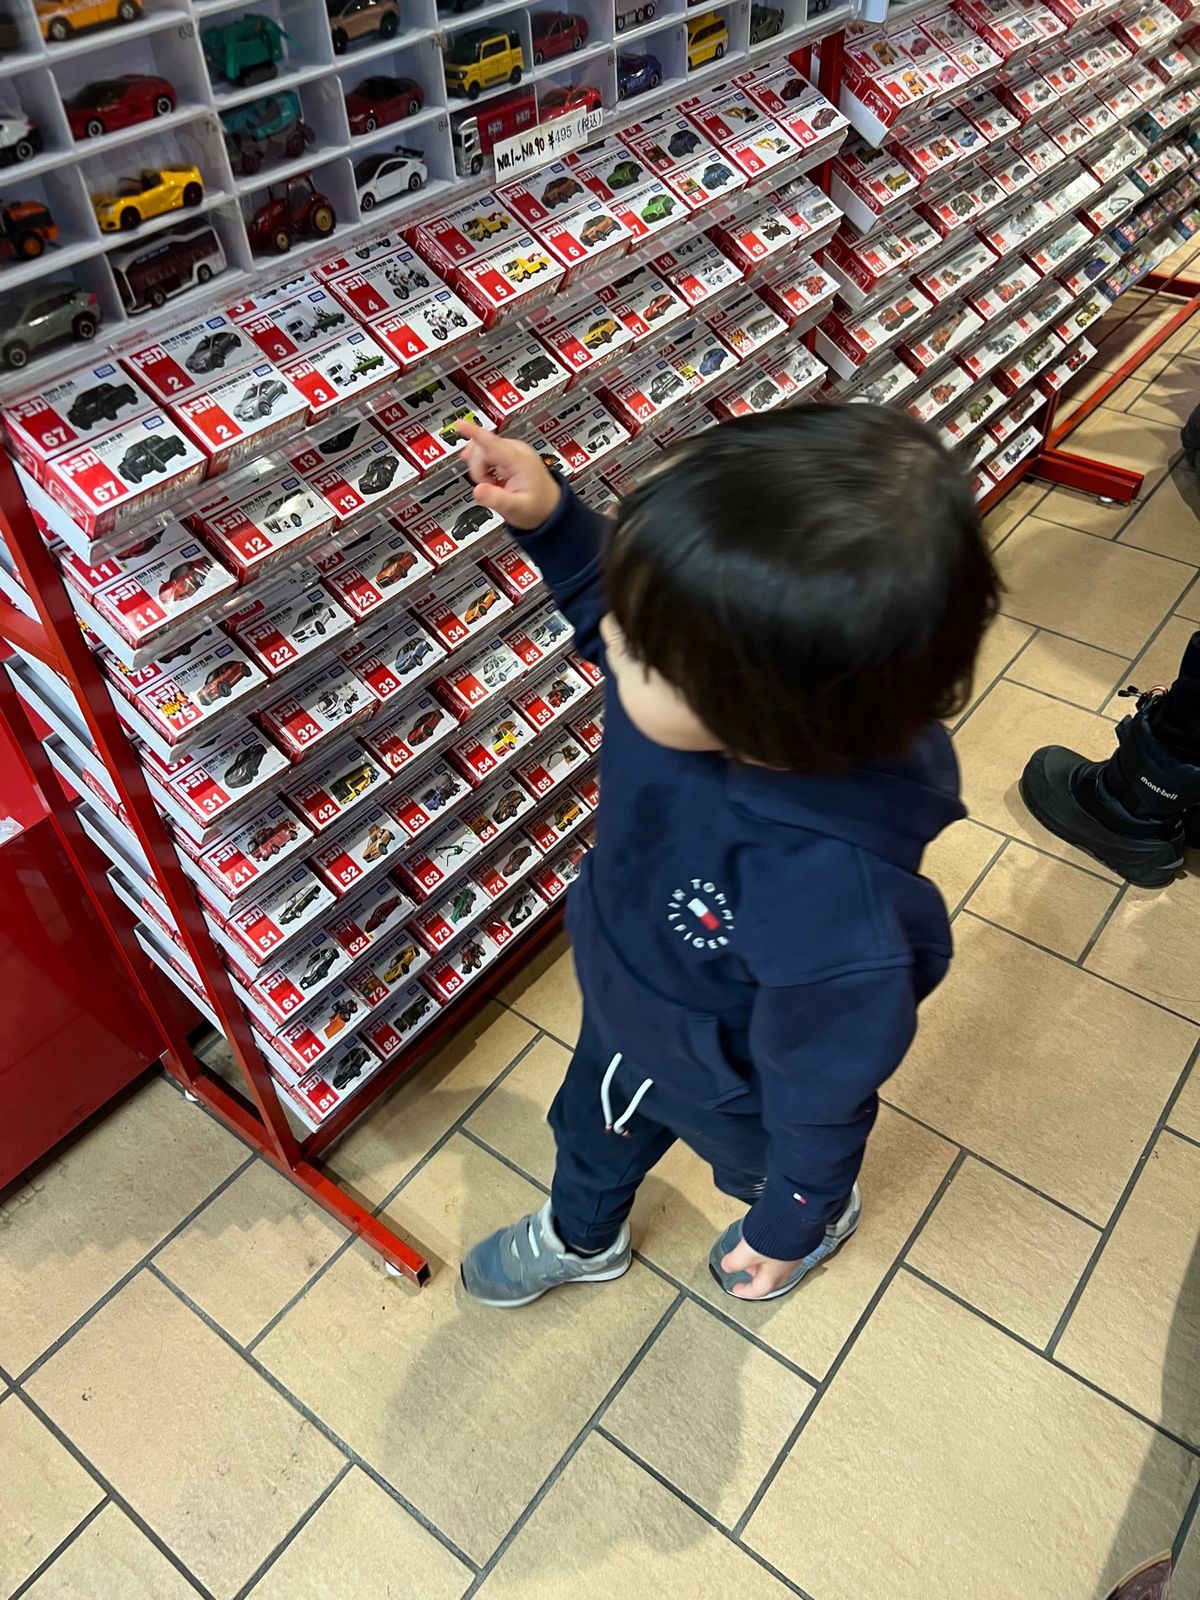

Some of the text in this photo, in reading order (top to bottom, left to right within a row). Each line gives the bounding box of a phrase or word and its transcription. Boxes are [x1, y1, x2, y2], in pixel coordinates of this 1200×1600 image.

[895, 92, 906, 103] 91
[771, 101, 782, 110] 10
[700, 110, 715, 122] トミカ
[782, 113, 797, 126] トミカ
[718, 129, 727, 138] 9
[801, 130, 814, 140] 10
[729, 142, 746, 155] トミカ
[660, 159, 668, 167] 8
[750, 160, 759, 169] 9
[577, 169, 594, 182] トミカ
[504, 186, 527, 202] トミカ
[595, 191, 605, 200] 7
[694, 192, 702, 201] 8
[530, 208, 540, 218] 6
[613, 203, 632, 216] トミカ
[427, 220, 450, 236] トミカ
[542, 224, 564, 240] トミカ
[633, 224, 642, 235] 7
[456, 244, 466, 255] 5
[569, 246, 579, 256] 6
[751, 243, 764, 254] 19
[660, 255, 674, 267] 18
[467, 262, 490, 280] トミカ
[337, 274, 366, 293] トミカ
[496, 285, 508, 297] 5
[601, 290, 612, 301] 17
[690, 285, 704, 298] 18
[368, 299, 379, 311] 4
[793, 296, 807, 309] 30
[615, 304, 631, 317] トミカ
[243, 317, 274, 337] トミカ
[376, 318, 404, 336] トミカ
[632, 323, 644, 334] 17
[552, 329, 571, 344] トミカ
[274, 344, 287, 356] 3
[407, 341, 419, 354] 4
[132, 347, 167, 368] トミカ
[572, 351, 588, 363] 16
[284, 362, 314, 382] トミカ
[481, 372, 500, 387] トミカ
[168, 376, 184, 390] 2
[783, 383, 796, 393] 40
[314, 389, 328, 401] 3
[502, 391, 519, 406] 15
[618, 384, 638, 400] トミカ
[11, 400, 49, 421] トミカ
[180, 396, 216, 418] トミカ
[384, 408, 401, 421] 14
[637, 404, 652, 419] 27
[41, 427, 69, 447] 67
[216, 425, 232, 440] 2
[399, 425, 424, 442] トミカ
[552, 434, 572, 449] トミカ
[423, 446, 440, 460] 14
[570, 453, 586, 466] 26
[60, 452, 100, 476] トミカ
[299, 455, 316, 468] 13
[311, 473, 341, 491] トミカ
[92, 481, 120, 501] 67
[340, 495, 358, 510] 13
[214, 511, 247, 532] トミカ
[414, 520, 438, 537] トミカ
[244, 537, 266, 554] 12
[435, 540, 453, 557] 24
[497, 552, 518, 568] トミカ
[90, 564, 113, 582] 11
[332, 568, 361, 588] トミカ
[518, 572, 534, 586] 35
[106, 581, 140, 605] トミカ
[359, 590, 377, 608] 23
[136, 610, 159, 626] 11
[428, 604, 450, 623] トミカ
[247, 623, 276, 643] トミカ
[448, 626, 465, 641] 34
[271, 646, 293, 664] 22
[524, 649, 539, 663] 45
[134, 665, 156, 683] 75
[357, 656, 380, 677] トミカ
[378, 678, 396, 694] 33
[469, 686, 485, 700] 44
[174, 707, 197, 726] 75
[274, 701, 300, 721] トミカ
[536, 708, 551, 722] 55
[297, 724, 318, 742] 32
[589, 733, 601, 744] 66
[392, 750, 409, 764] 43
[477, 758, 494, 772] 54
[178, 769, 208, 792] トミカ
[537, 777, 551, 790] 65
[202, 793, 224, 811] 31
[316, 803, 337, 820] 42
[408, 813, 426, 829] 53
[480, 826, 495, 840] 64
[542, 834, 556, 847] 75
[210, 844, 238, 866] トミカ
[233, 866, 252, 884] 41
[339, 866, 359, 884] 52
[423, 870, 440, 886] 63
[489, 880, 504, 894] 74
[549, 882, 562, 894] 85
[237, 909, 262, 930] トミカ
[258, 932, 279, 949] 51
[434, 927, 451, 942] 73
[497, 930, 510, 943] 84
[350, 936, 366, 951] 62
[261, 971, 286, 993] トミカ
[445, 976, 461, 991] 83
[282, 994, 300, 1010] 61
[369, 986, 386, 1003] 72
[383, 1037, 400, 1050] 82
[303, 1044, 321, 1064] 71
[319, 1093, 338, 1109] 81
